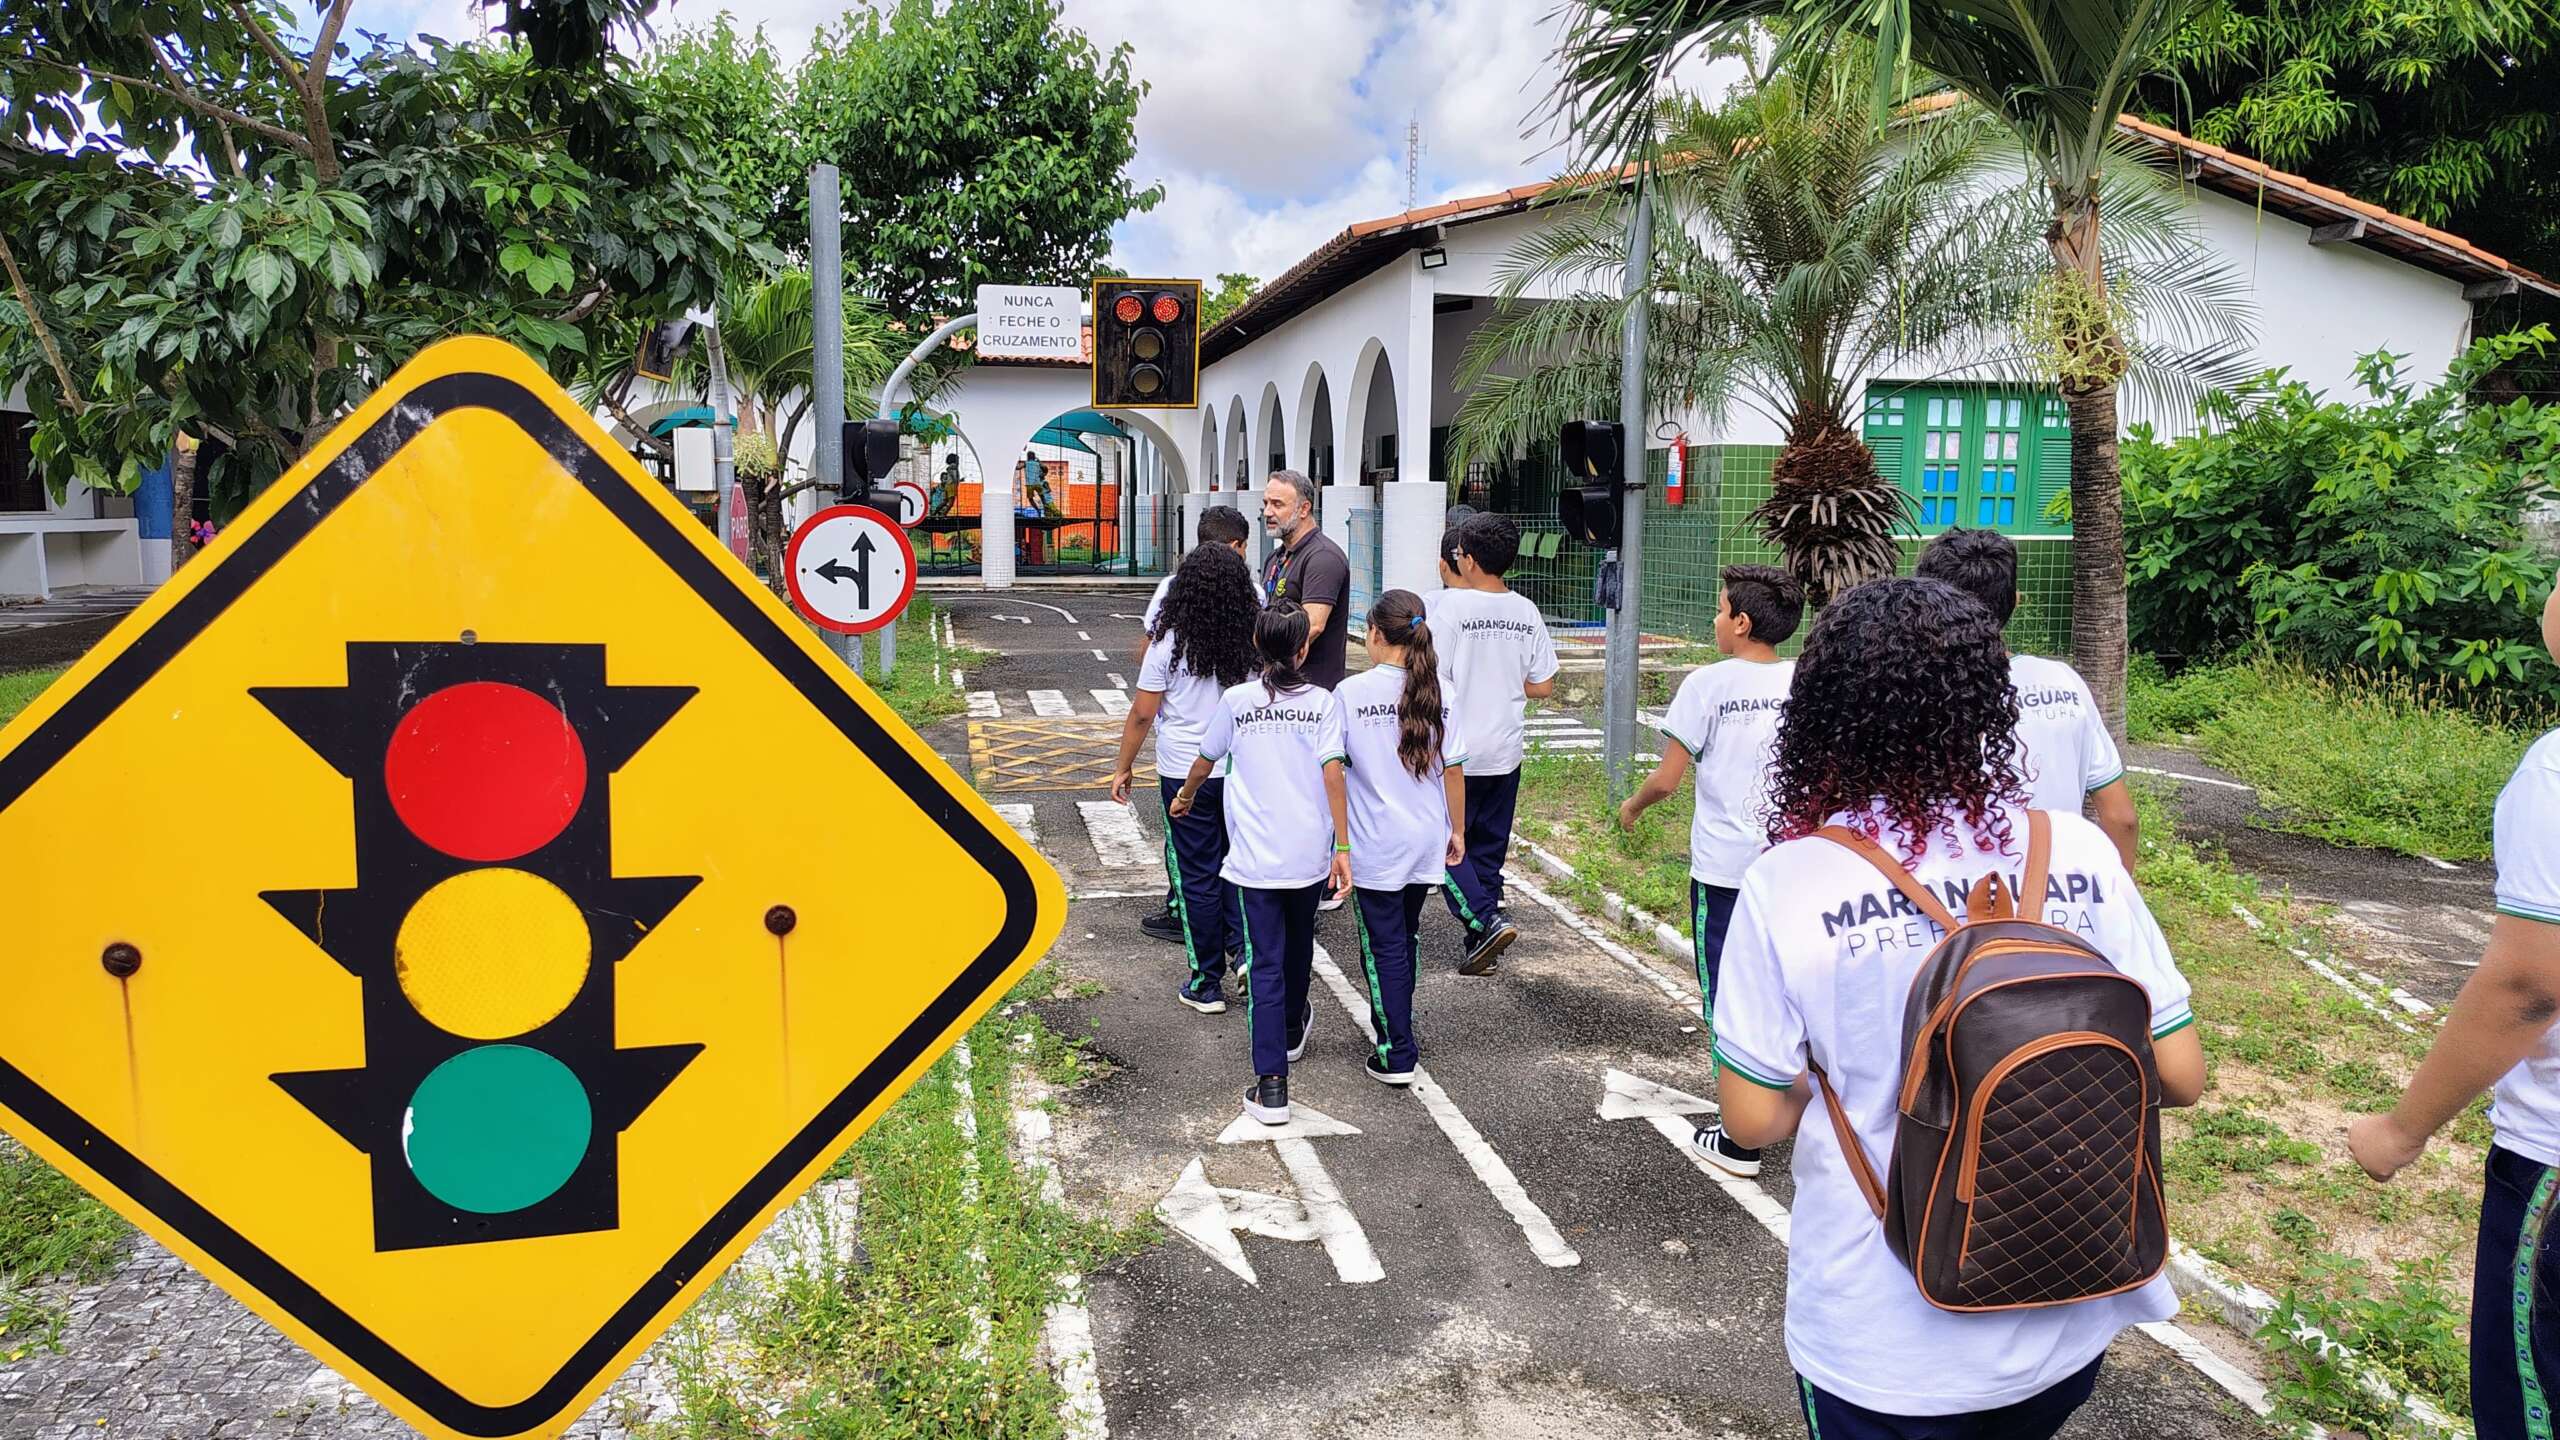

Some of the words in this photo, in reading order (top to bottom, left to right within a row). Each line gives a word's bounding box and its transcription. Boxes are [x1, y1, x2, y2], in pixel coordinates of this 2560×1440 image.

[1004, 295, 1054, 307] NUNCA
[999, 315, 1046, 328] FECHE
[1050, 316, 1061, 328] O
[982, 335, 1078, 348] CRUZAMENTO
[1461, 619, 1535, 635] MARANGUAPE
